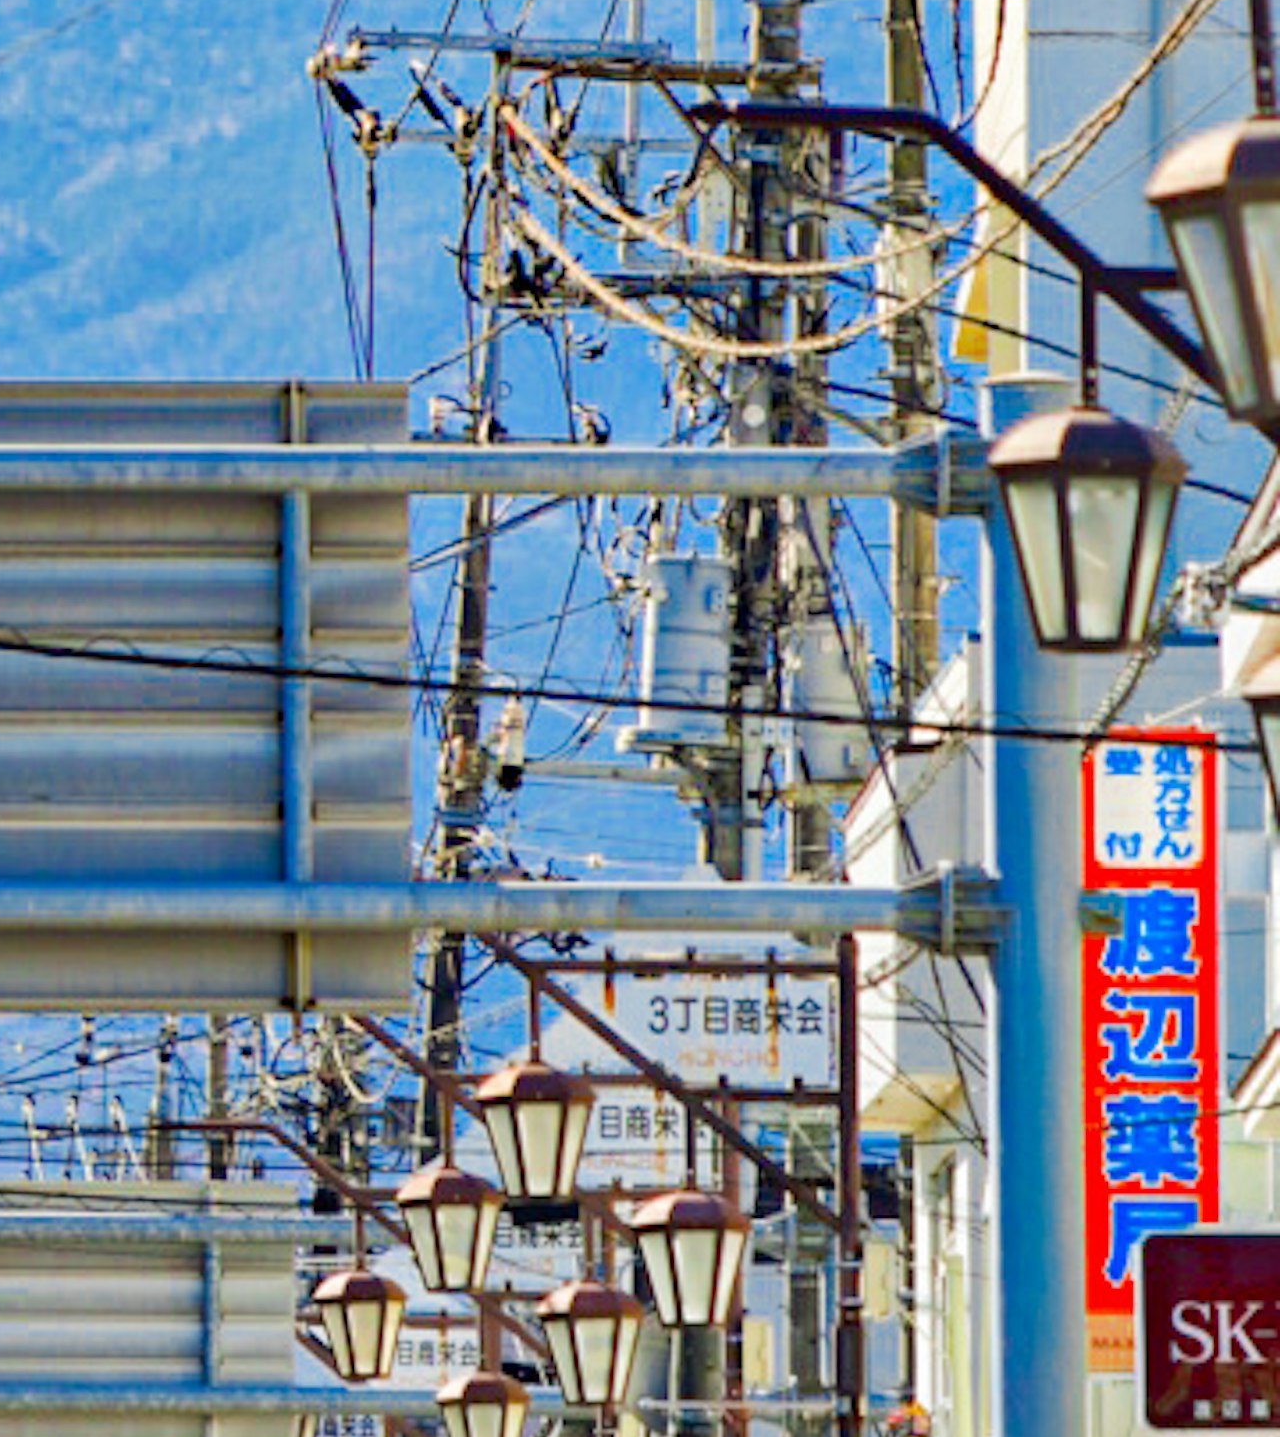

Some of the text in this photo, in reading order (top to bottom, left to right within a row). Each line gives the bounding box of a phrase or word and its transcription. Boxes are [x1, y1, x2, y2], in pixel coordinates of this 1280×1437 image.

[648, 995, 823, 1035] 3丁目商栄会
